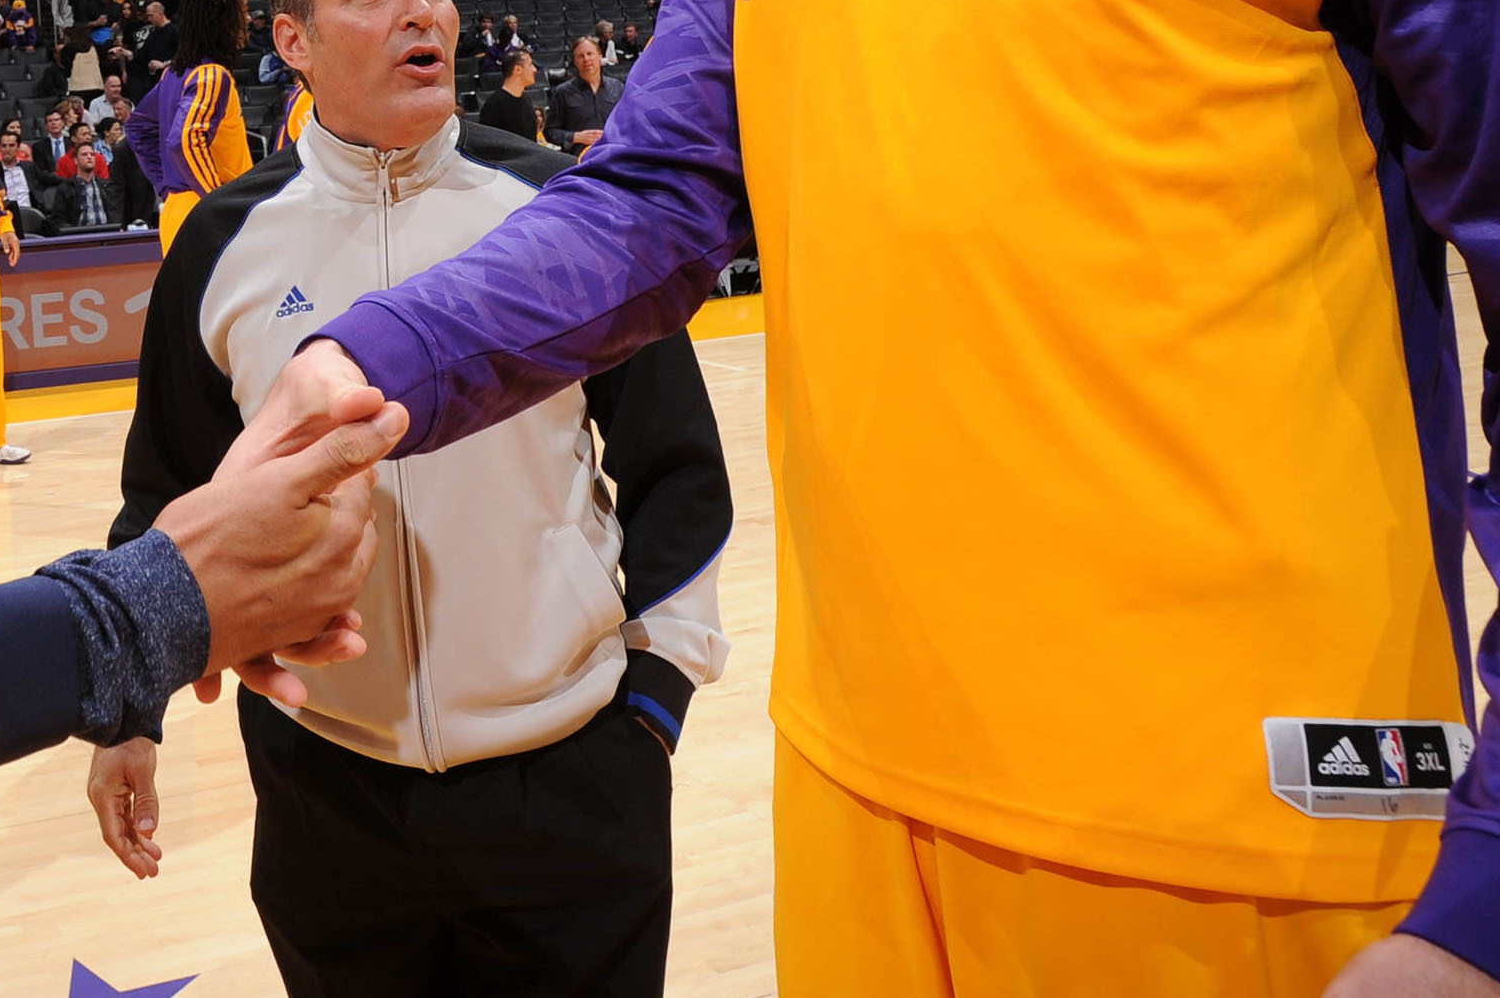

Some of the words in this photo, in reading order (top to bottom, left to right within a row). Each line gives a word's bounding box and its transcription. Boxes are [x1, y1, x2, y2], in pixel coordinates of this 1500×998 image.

[1, 288, 108, 349] RES
[276, 302, 314, 319] adidas
[1317, 760, 1371, 777] adidas
[1415, 751, 1447, 771] 3XL
